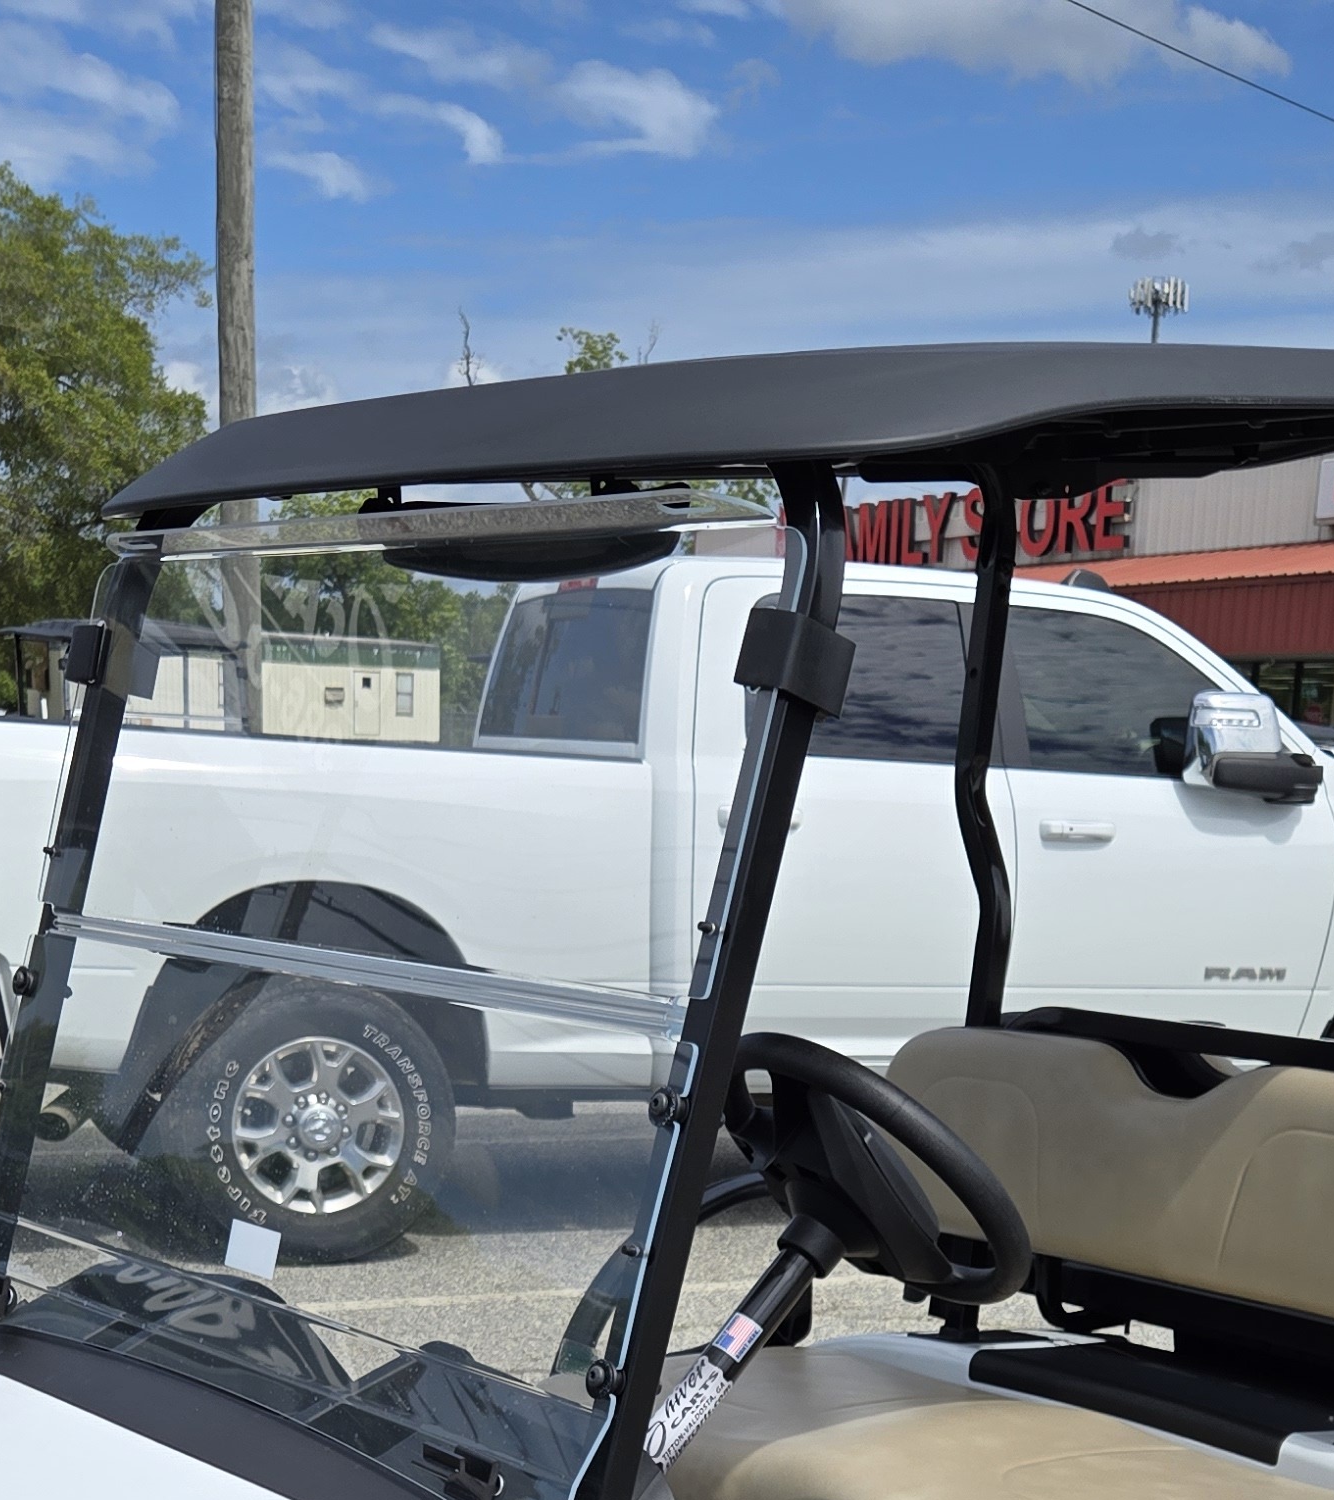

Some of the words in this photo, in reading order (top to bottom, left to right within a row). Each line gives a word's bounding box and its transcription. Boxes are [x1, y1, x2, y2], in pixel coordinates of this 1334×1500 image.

[962, 478, 1128, 561] SORE
[1204, 966, 1287, 982] RAM
[363, 1024, 432, 1166] TRANSFORCE
[206, 1060, 267, 1225] Firestone
[670, 1370, 719, 1430] CARTS
[715, 1381, 725, 1394] GA
